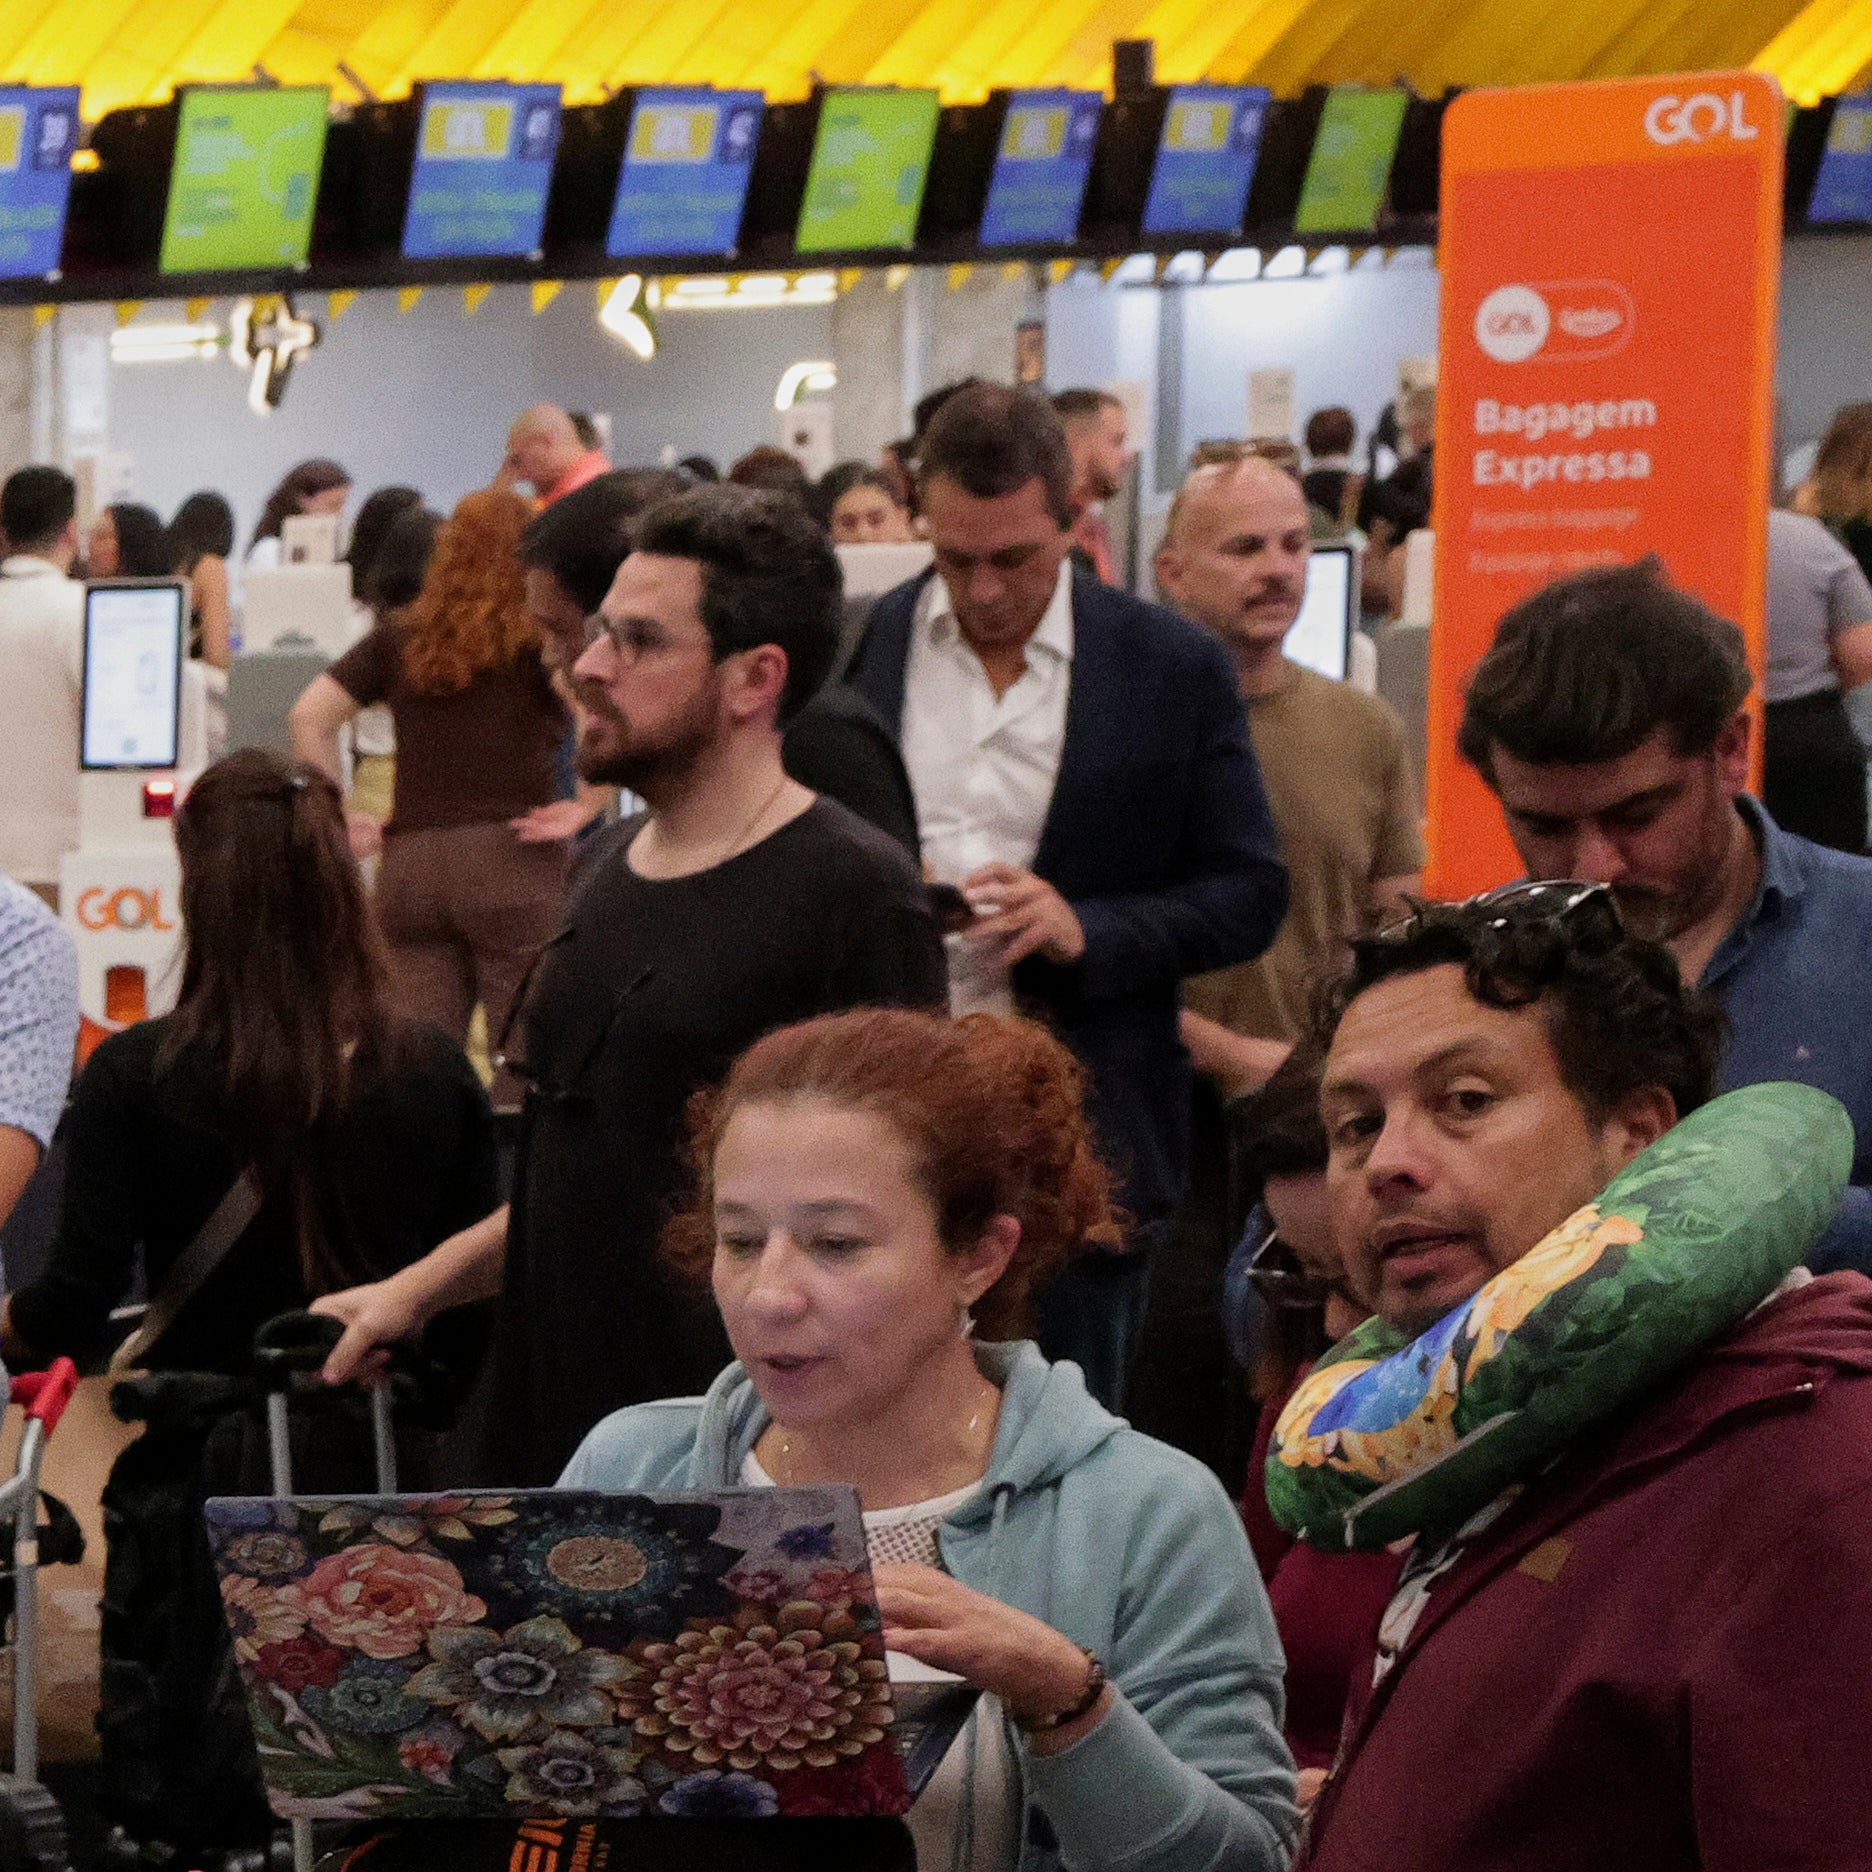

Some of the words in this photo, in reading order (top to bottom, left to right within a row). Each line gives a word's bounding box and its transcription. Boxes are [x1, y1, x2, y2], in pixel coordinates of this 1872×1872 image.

[1644, 90, 1758, 145] GOL
[1474, 398, 1657, 441] Bagagem
[1473, 449, 1651, 491] Expressa
[77, 887, 172, 932] GOL
